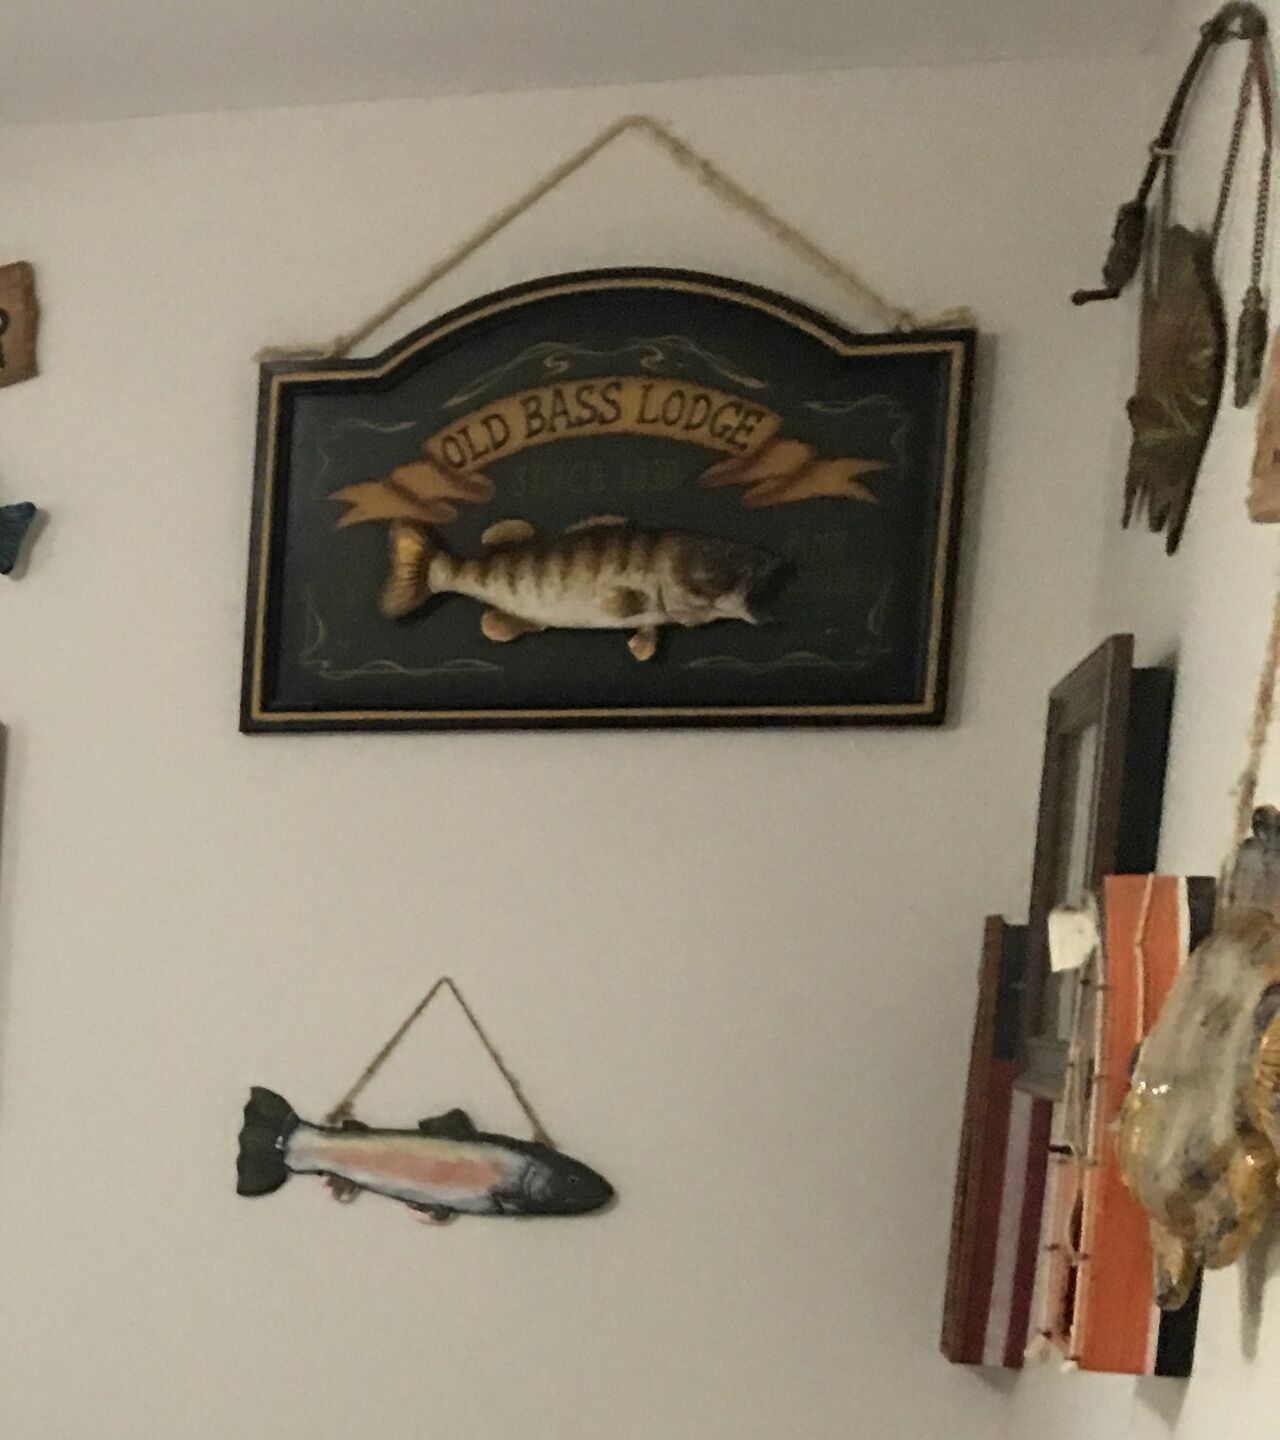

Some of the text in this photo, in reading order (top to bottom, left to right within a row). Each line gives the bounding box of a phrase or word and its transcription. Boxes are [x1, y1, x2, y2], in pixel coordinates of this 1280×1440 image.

[441, 381, 766, 469] OLD BASS LODGE
